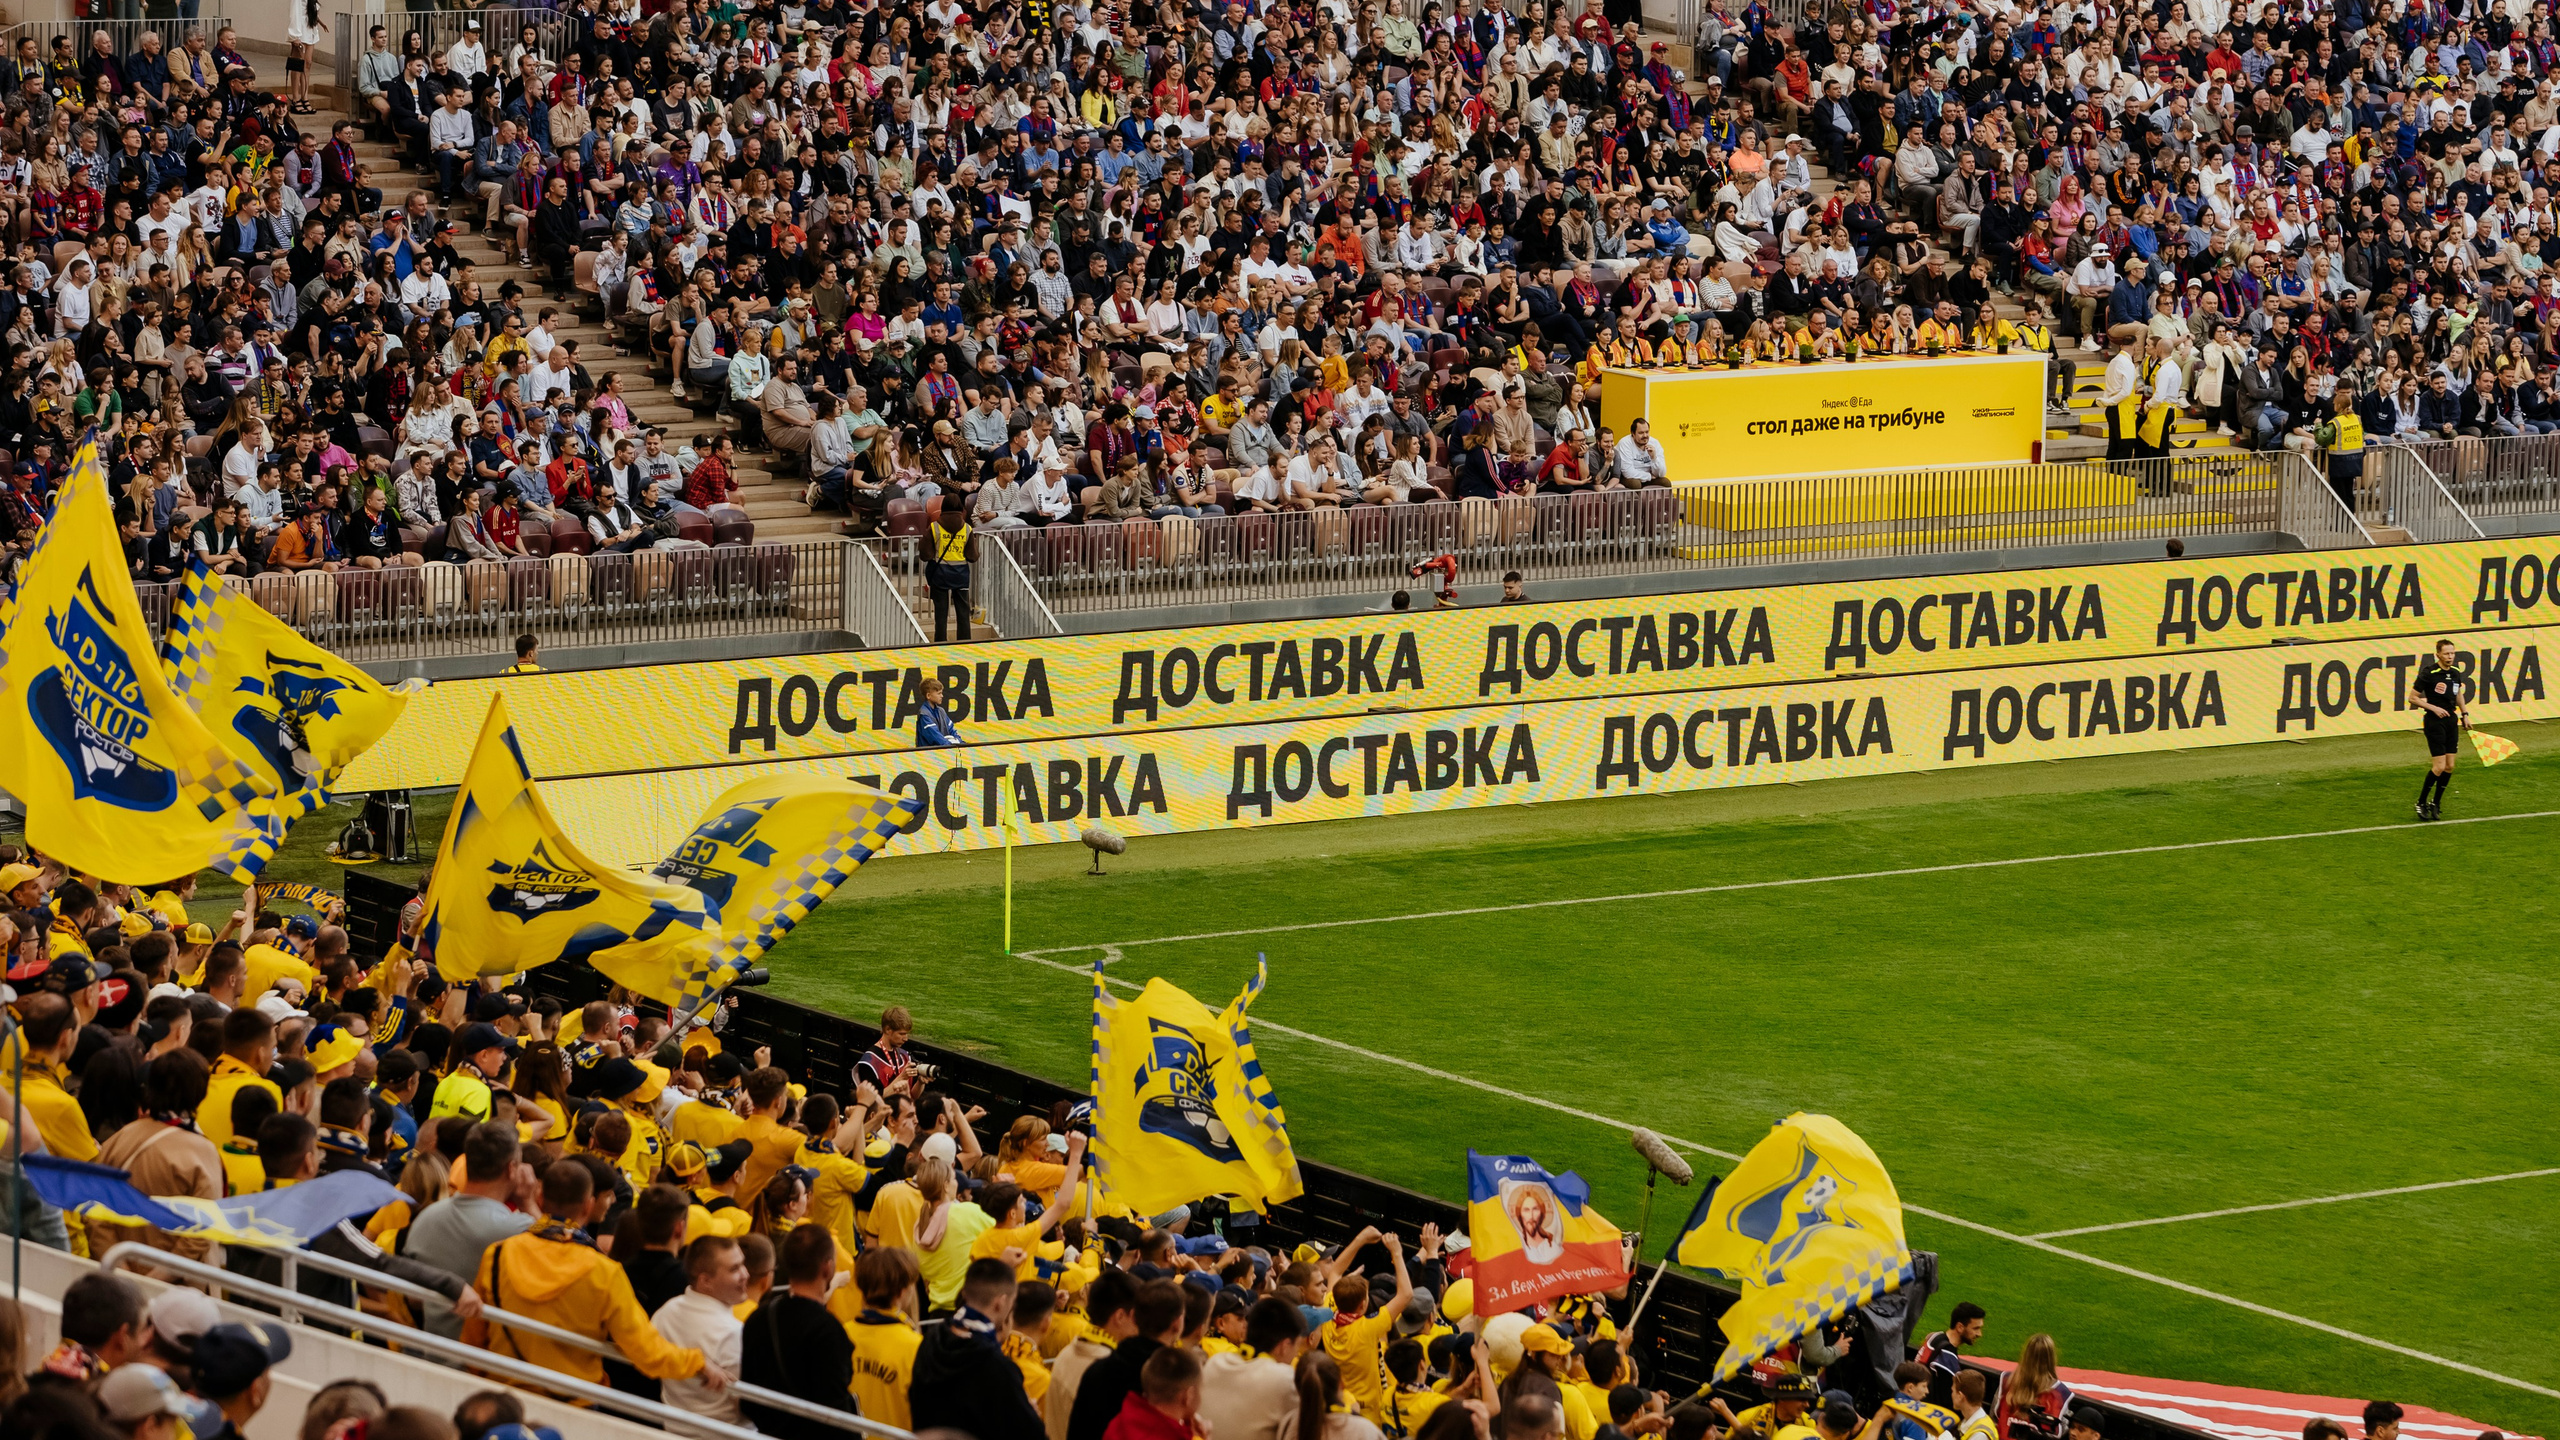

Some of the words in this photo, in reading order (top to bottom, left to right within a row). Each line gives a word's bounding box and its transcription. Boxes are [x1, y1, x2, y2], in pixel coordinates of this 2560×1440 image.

[1746, 420, 1787, 436] стол
[1790, 415, 1840, 437] даже
[1844, 414, 1865, 430] на
[1868, 406, 1946, 432] трибуне
[1821, 399, 1849, 409] Яндекс
[1858, 397, 1873, 407] Еда
[77, 635, 139, 703] D-116
[729, 658, 1054, 753] ДОСТАВКА
[1113, 632, 1424, 724] ДОСТАВКА
[1479, 607, 1774, 696] ДОСТАВКА
[1825, 584, 2106, 670] ДОСТАВКА
[2157, 564, 2424, 646] ДОСТАВКА
[74, 716, 135, 763] РОСТОВ
[847, 753, 1168, 834] ОСТАВКА
[1227, 724, 1540, 820] ДОСТАВКА
[1596, 697, 1893, 789] ДОСТАВКА
[1943, 671, 2228, 760] ДОСТАВКА
